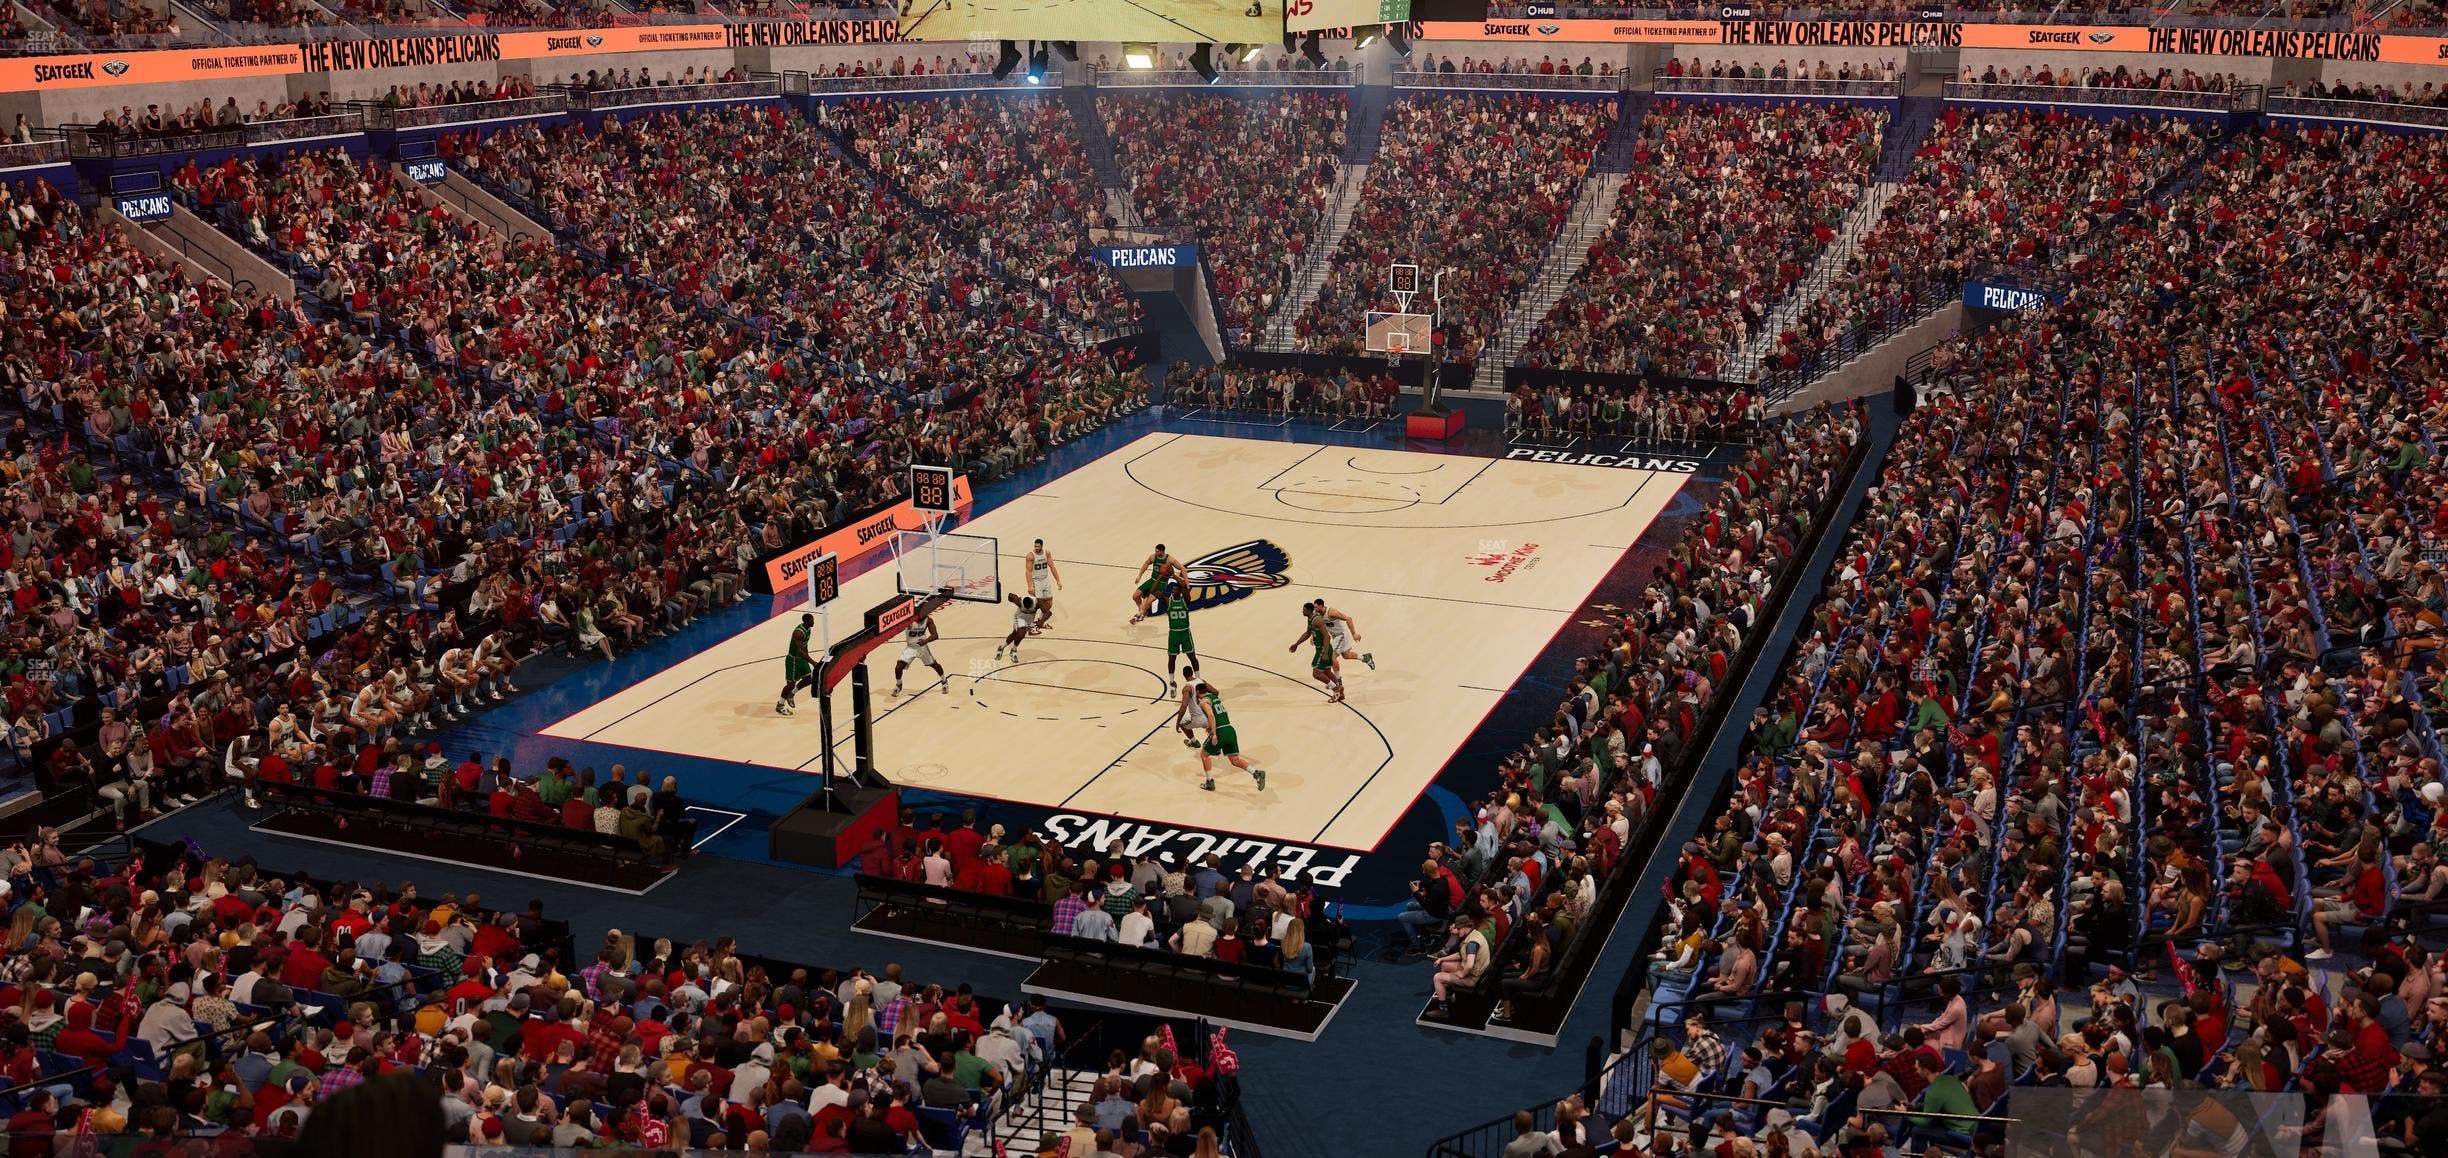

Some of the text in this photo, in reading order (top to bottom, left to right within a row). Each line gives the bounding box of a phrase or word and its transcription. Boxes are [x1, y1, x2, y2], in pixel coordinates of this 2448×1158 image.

[638, 34, 658, 44] OFFICIAL
[659, 33, 689, 43] TICKETING
[689, 32, 714, 42] PARTNER
[714, 31, 722, 40] OF
[723, 23, 749, 47] THE
[752, 22, 780, 46] NEW
[784, 21, 849, 45] ORLEANS
[1484, 23, 1530, 36] SEATGEEK
[1614, 27, 1642, 36] OFFICIAL
[1644, 27, 1677, 36] TICKETING
[1679, 27, 1708, 37] PARTNER
[1709, 28, 1718, 37] OF
[1720, 21, 1750, 44] THE
[1754, 22, 1792, 45] NEW
[1795, 22, 1875, 46] ORLEANS
[1878, 23, 1963, 47] PELICANS
[2028, 30, 2081, 44] SEATGEEK
[191, 34, 500, 73] OFFICIAL TICKETING PARTNER OF THE NEW ORLEANS PELICANS
[547, 36, 582, 51] SEATGEEK
[2148, 27, 2381, 62] THE NEW ORLEANS PELICANS
[34, 62, 95, 83] SEATGEEK
[409, 162, 445, 181] PELICANS
[122, 197, 170, 218] PELICANS
[1112, 247, 1176, 267] PELICANS
[1505, 448, 1700, 473] PELICANS
[920, 485, 943, 506] 88
[857, 514, 898, 546] SEATGEEK
[882, 602, 913, 628] SEATGEEK
